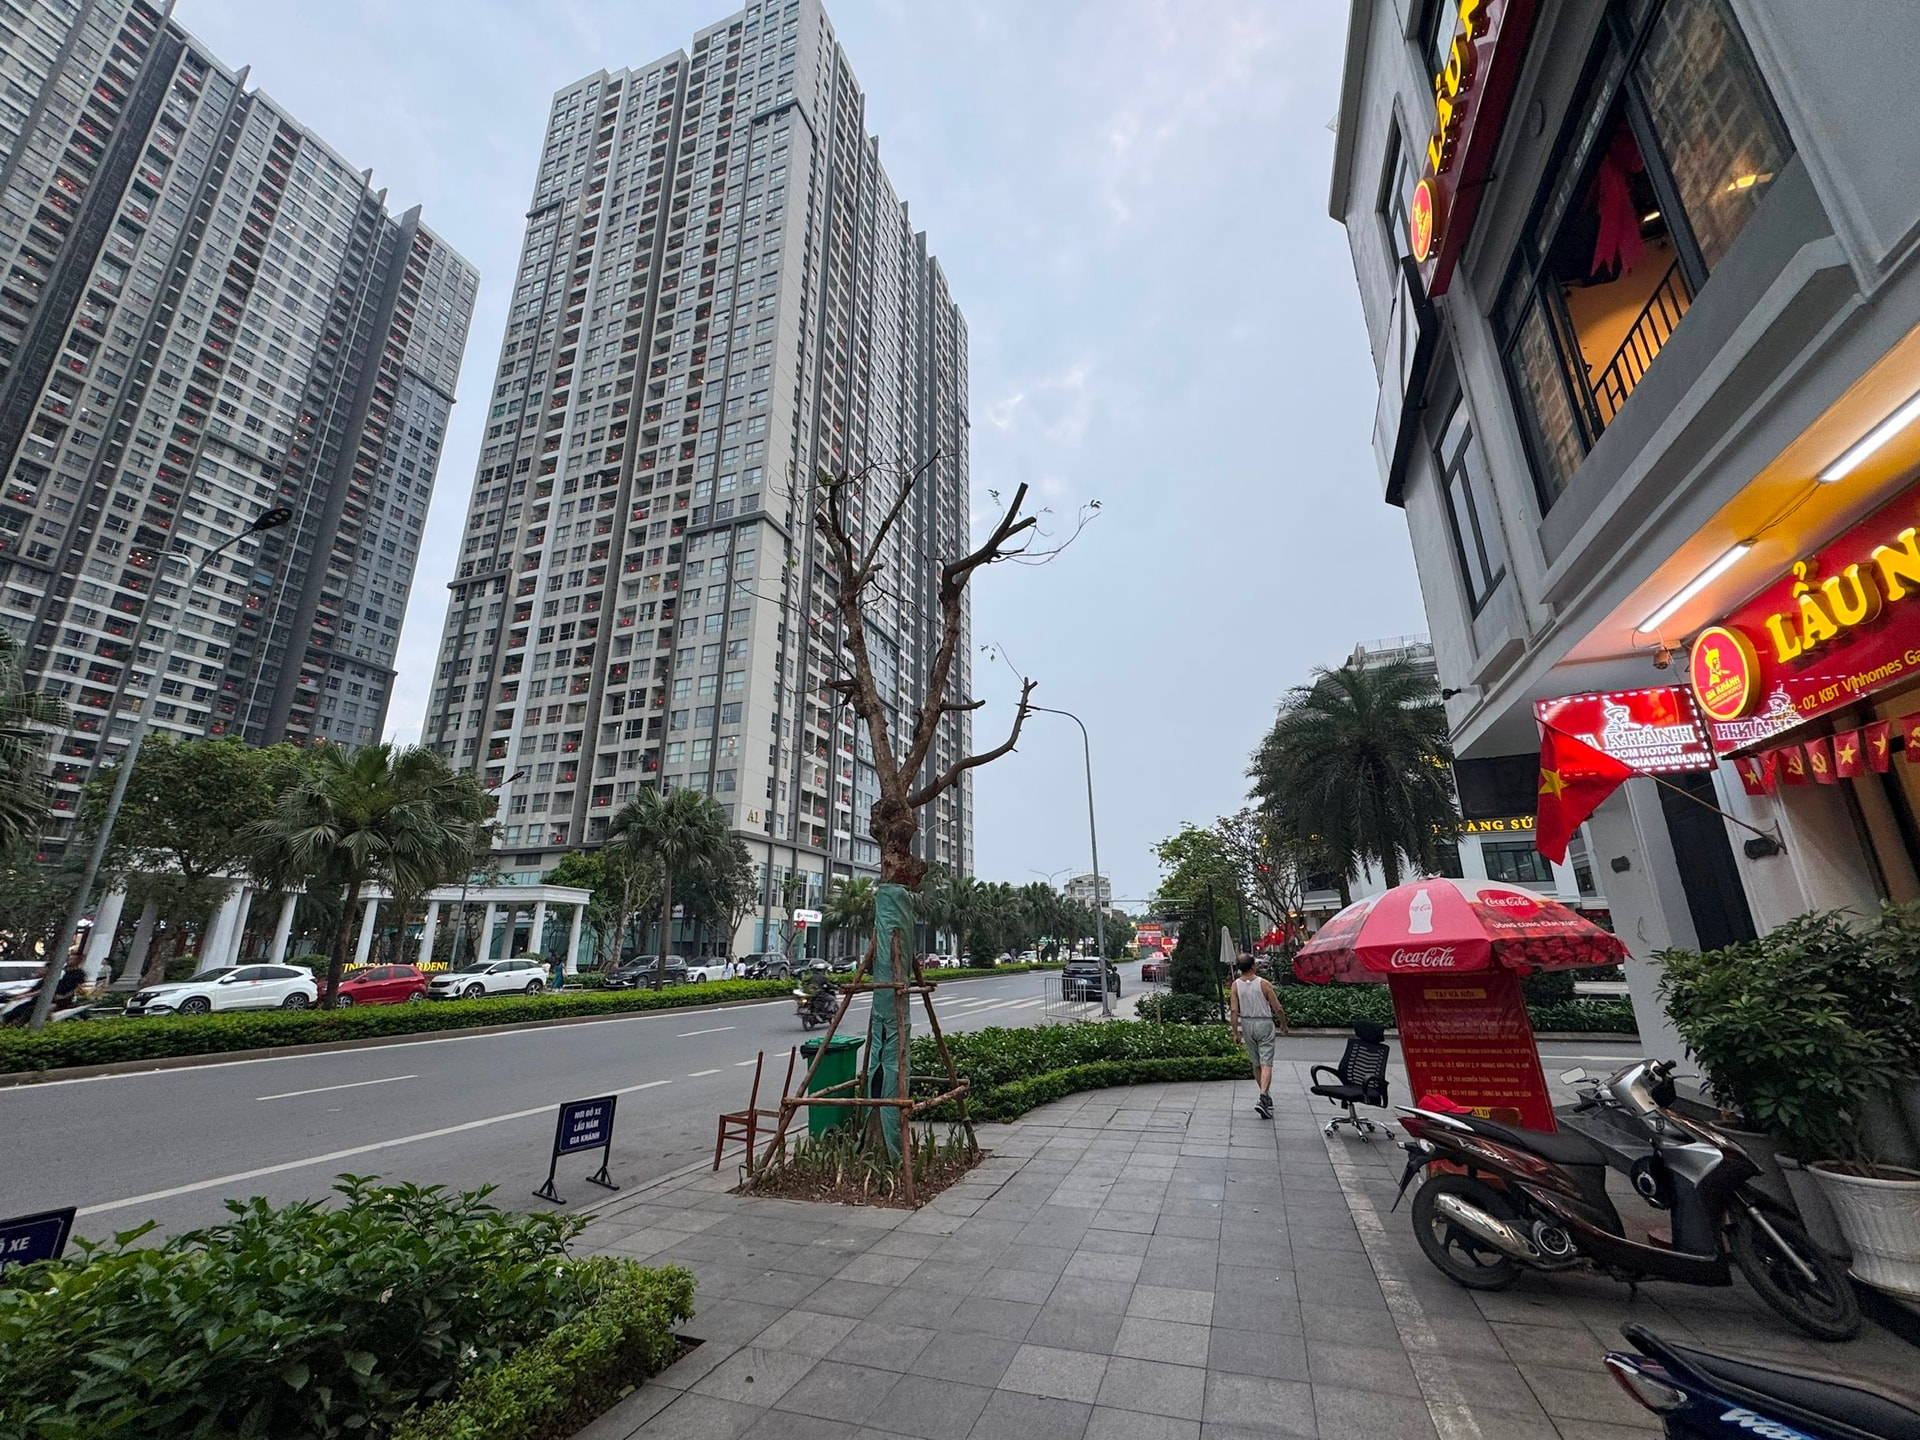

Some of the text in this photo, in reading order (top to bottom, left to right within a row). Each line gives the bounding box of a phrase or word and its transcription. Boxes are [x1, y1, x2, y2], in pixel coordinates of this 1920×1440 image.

[1765, 561, 1868, 664] LẨU
[1818, 683, 1840, 704] KBT
[1841, 659, 1903, 693] Vinhomes
[1604, 724, 1698, 749] KHÁNH
[1641, 745, 1683, 757] HOTPOT
[747, 809, 759, 823] A1
[1485, 896, 1530, 907] Coca-Cola
[1391, 946, 1456, 968] Coca-Cola
[594, 1107, 602, 1116] XE
[569, 1131, 600, 1144] GIA KHÁNH
[7, 1236, 31, 1253] XE
